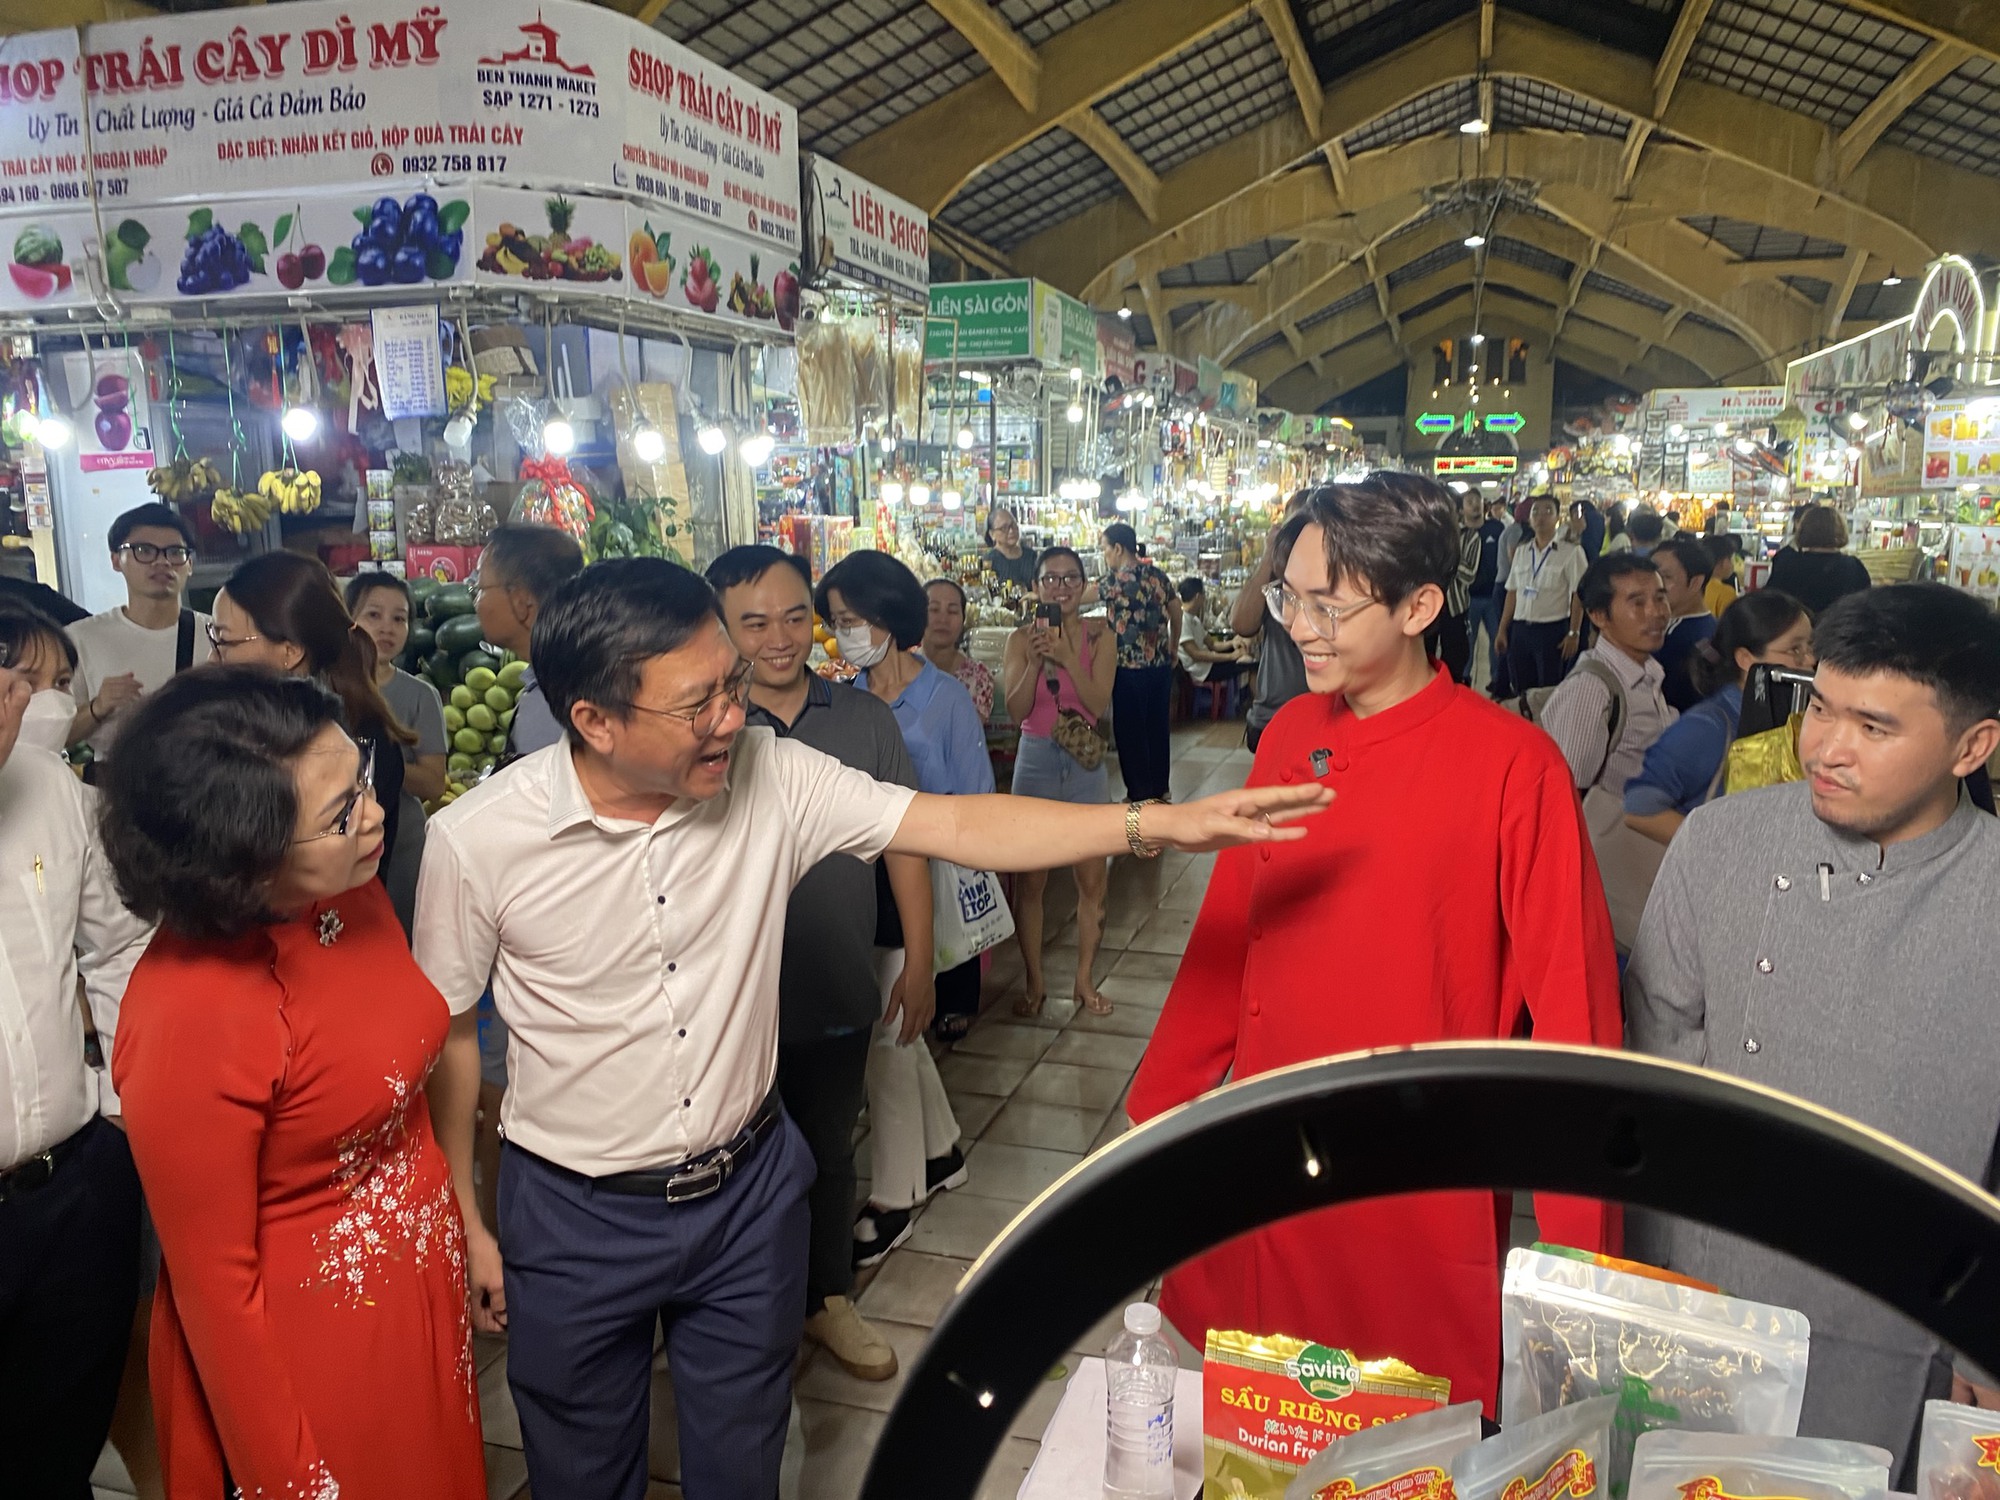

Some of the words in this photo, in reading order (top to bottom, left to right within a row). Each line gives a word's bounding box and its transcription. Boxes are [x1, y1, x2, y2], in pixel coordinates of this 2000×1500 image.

[74, 36, 184, 93] TRÁI
[193, 25, 291, 84] CÂY
[302, 14, 357, 75] DÌ
[368, 6, 448, 69] MỸ
[477, 69, 505, 84] BEN
[508, 70, 553, 89] THANH
[556, 75, 597, 96] MAKET
[96, 103, 135, 133] Chất
[142, 104, 195, 134] Lượng
[214, 97, 244, 123] Giá
[250, 92, 274, 119] Cả
[280, 89, 323, 117] Đảm
[330, 84, 366, 112] Bảo
[483, 89, 514, 112] SẠP
[518, 91, 552, 112] 1271
[569, 97, 600, 119] 1273
[628, 47, 675, 105] SHOP
[676, 70, 714, 122] TRÁI
[715, 85, 744, 138] CÂY
[746, 101, 762, 144] DÌ
[763, 111, 783, 154] MỸ
[217, 137, 244, 165] ĐẶC
[281, 132, 319, 158] NHẬN
[381, 124, 409, 151] HỘP
[414, 120, 444, 146] QUÀ
[448, 119, 486, 144] TRÁI
[491, 121, 524, 146] CÂY
[1, 154, 27, 176] TRÁI
[30, 153, 52, 174] CÂY
[55, 151, 77, 176] NỘI
[93, 148, 131, 174] NGOẠI
[134, 144, 168, 170] NHẬP
[402, 154, 438, 174] 0932
[441, 154, 472, 173] 758
[476, 154, 507, 173] 817
[0, 186, 16, 203] 94
[19, 184, 40, 203] 160
[82, 179, 104, 199] 07
[107, 177, 129, 197] 507
[852, 189, 885, 240] LIÊN
[927, 295, 961, 316] LIÊN
[964, 293, 989, 316] SÀI
[991, 292, 1028, 315] GÒN
[1285, 1358, 1360, 1384] Savina
[1220, 1386, 1270, 1413] SẦU
[1278, 1400, 1362, 1432] RIÊNG
[1238, 1427, 1288, 1455] Durian
